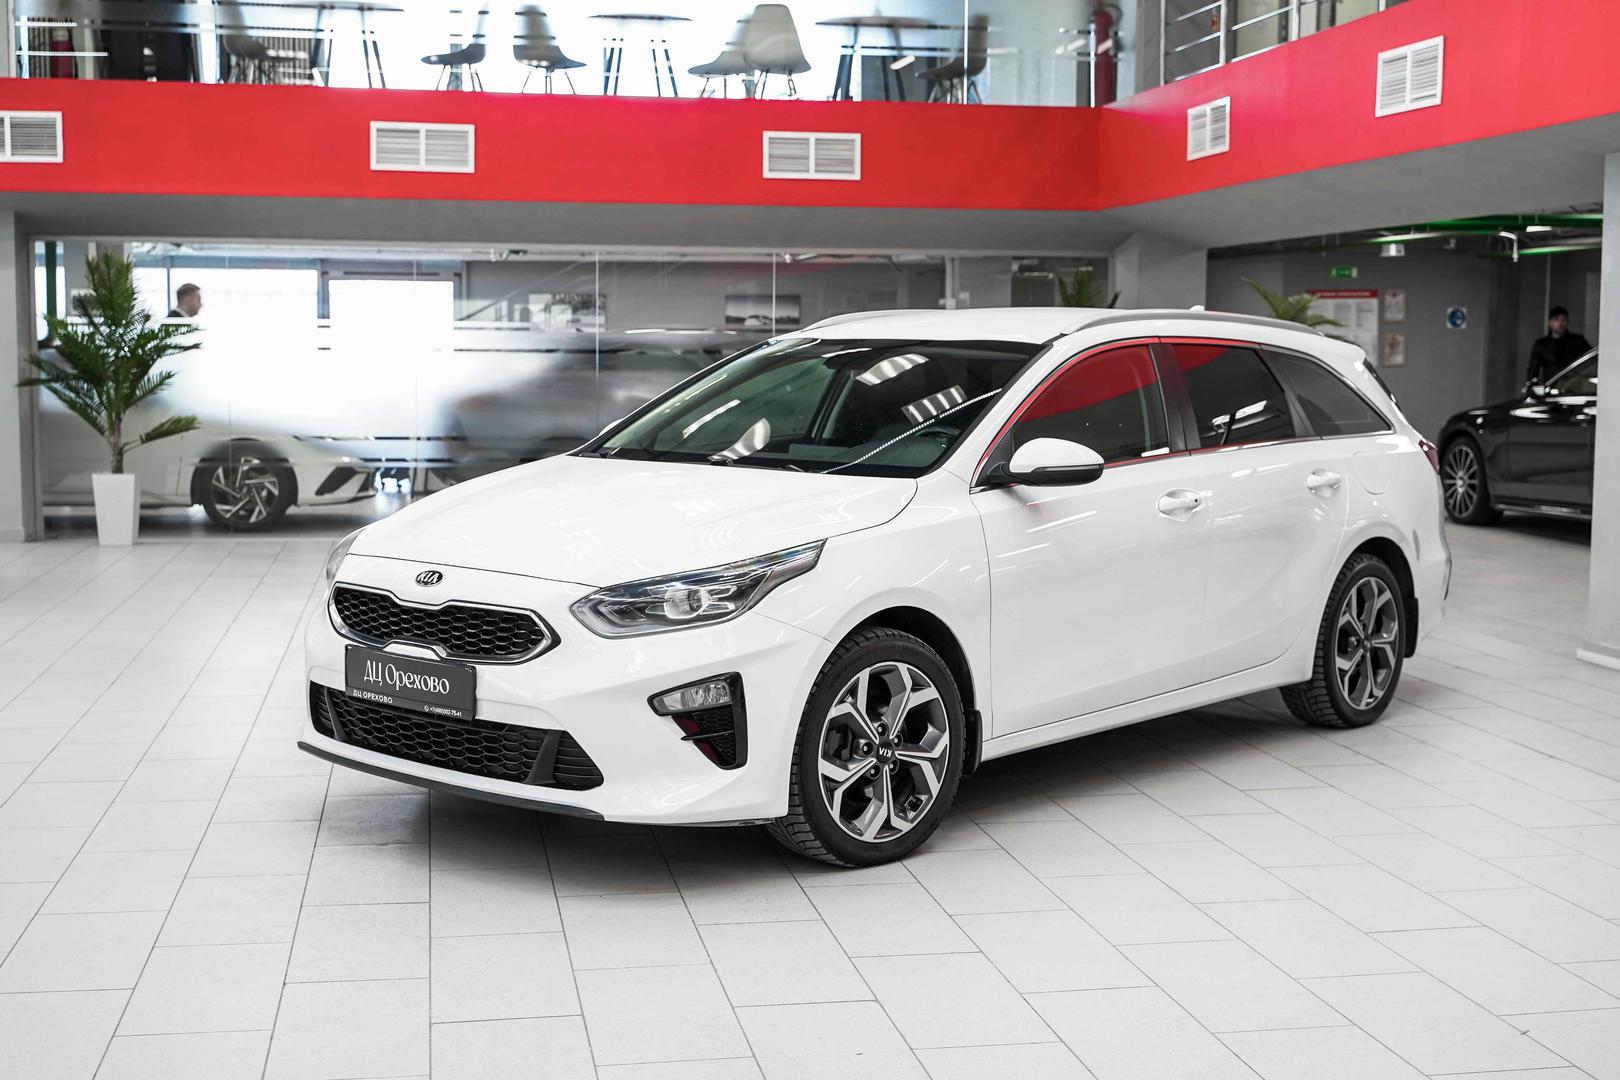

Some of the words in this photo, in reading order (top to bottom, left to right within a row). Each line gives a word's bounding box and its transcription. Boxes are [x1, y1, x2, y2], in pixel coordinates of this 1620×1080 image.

[417, 571, 440, 583] KIA
[364, 660, 382, 686] ДЦ
[385, 664, 449, 694] Орехово
[353, 690, 362, 698] ДЦ
[363, 691, 393, 703] ОРЕХОВО
